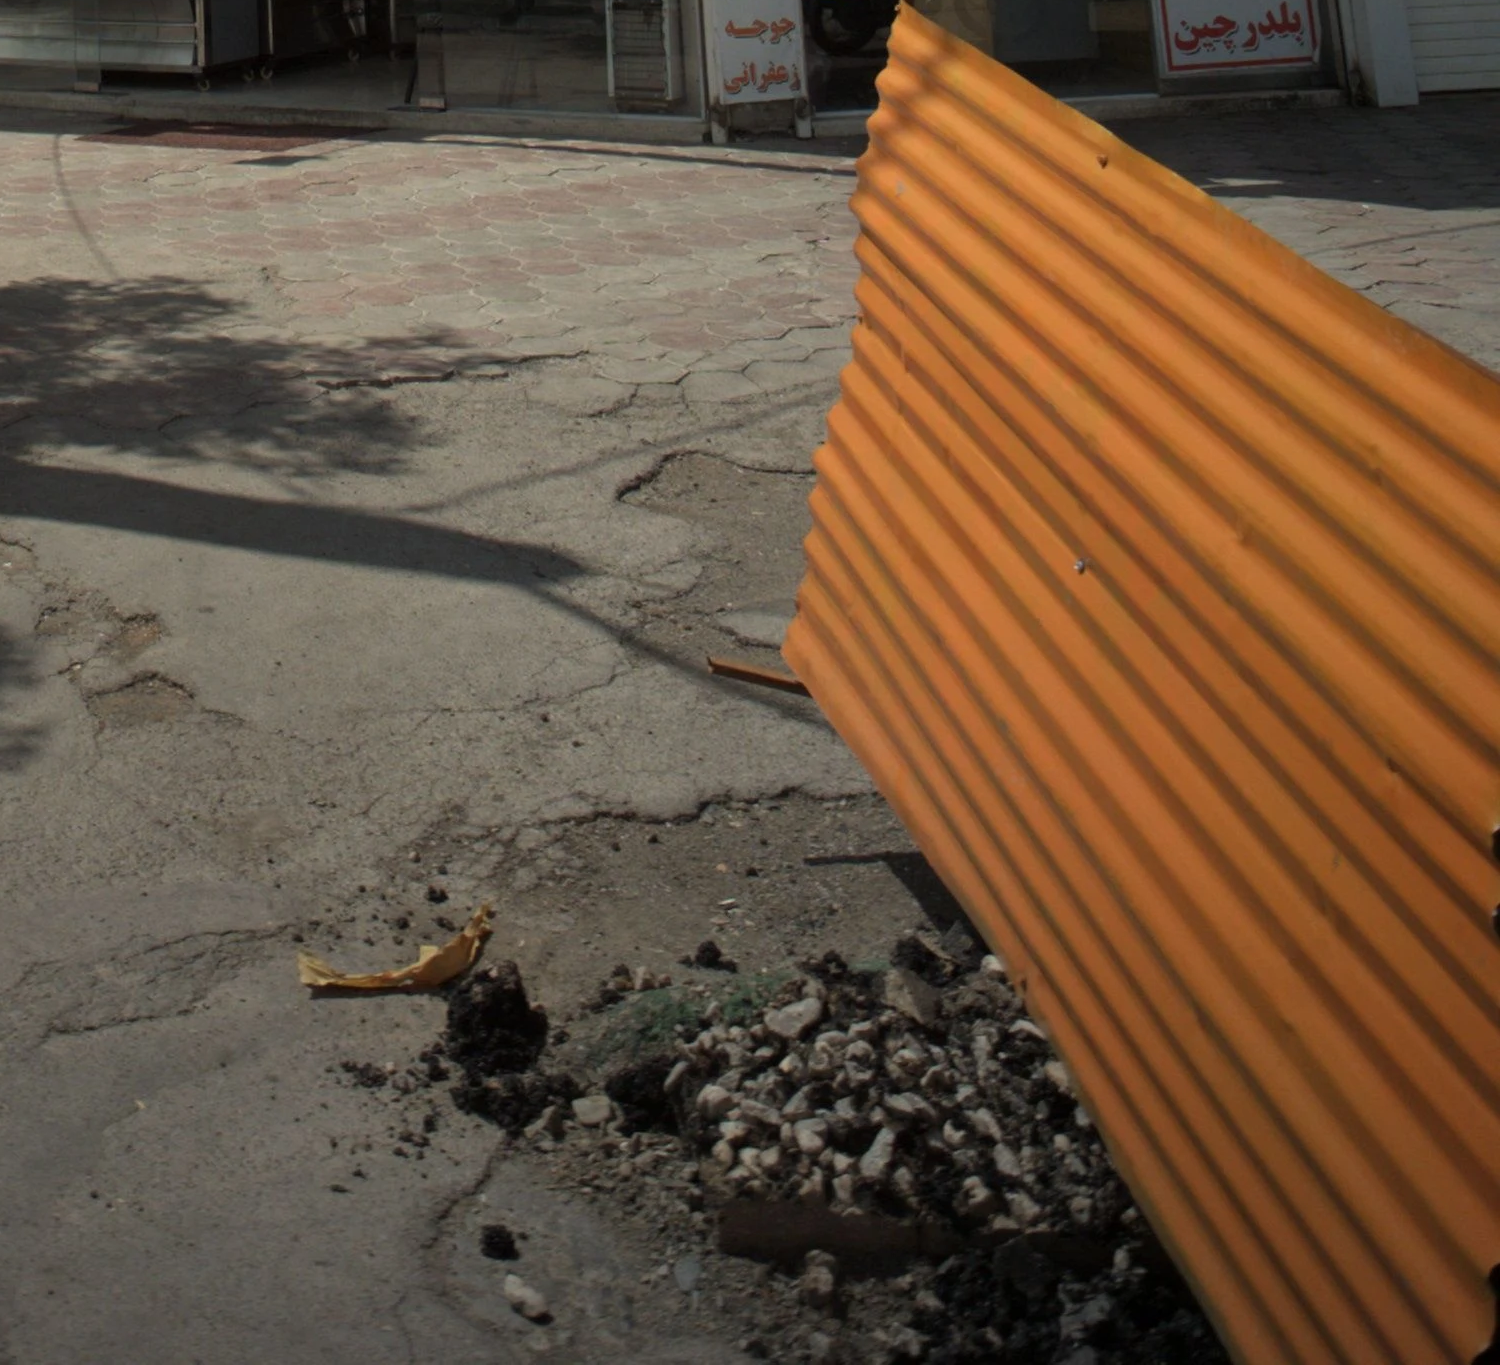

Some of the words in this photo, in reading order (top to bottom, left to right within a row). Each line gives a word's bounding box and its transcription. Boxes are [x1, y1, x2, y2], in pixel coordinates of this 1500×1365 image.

[725, 18, 795, 44] جوجه
[1173, 1, 1303, 52] بلدرچین
[724, 62, 800, 94] زعفرانی
